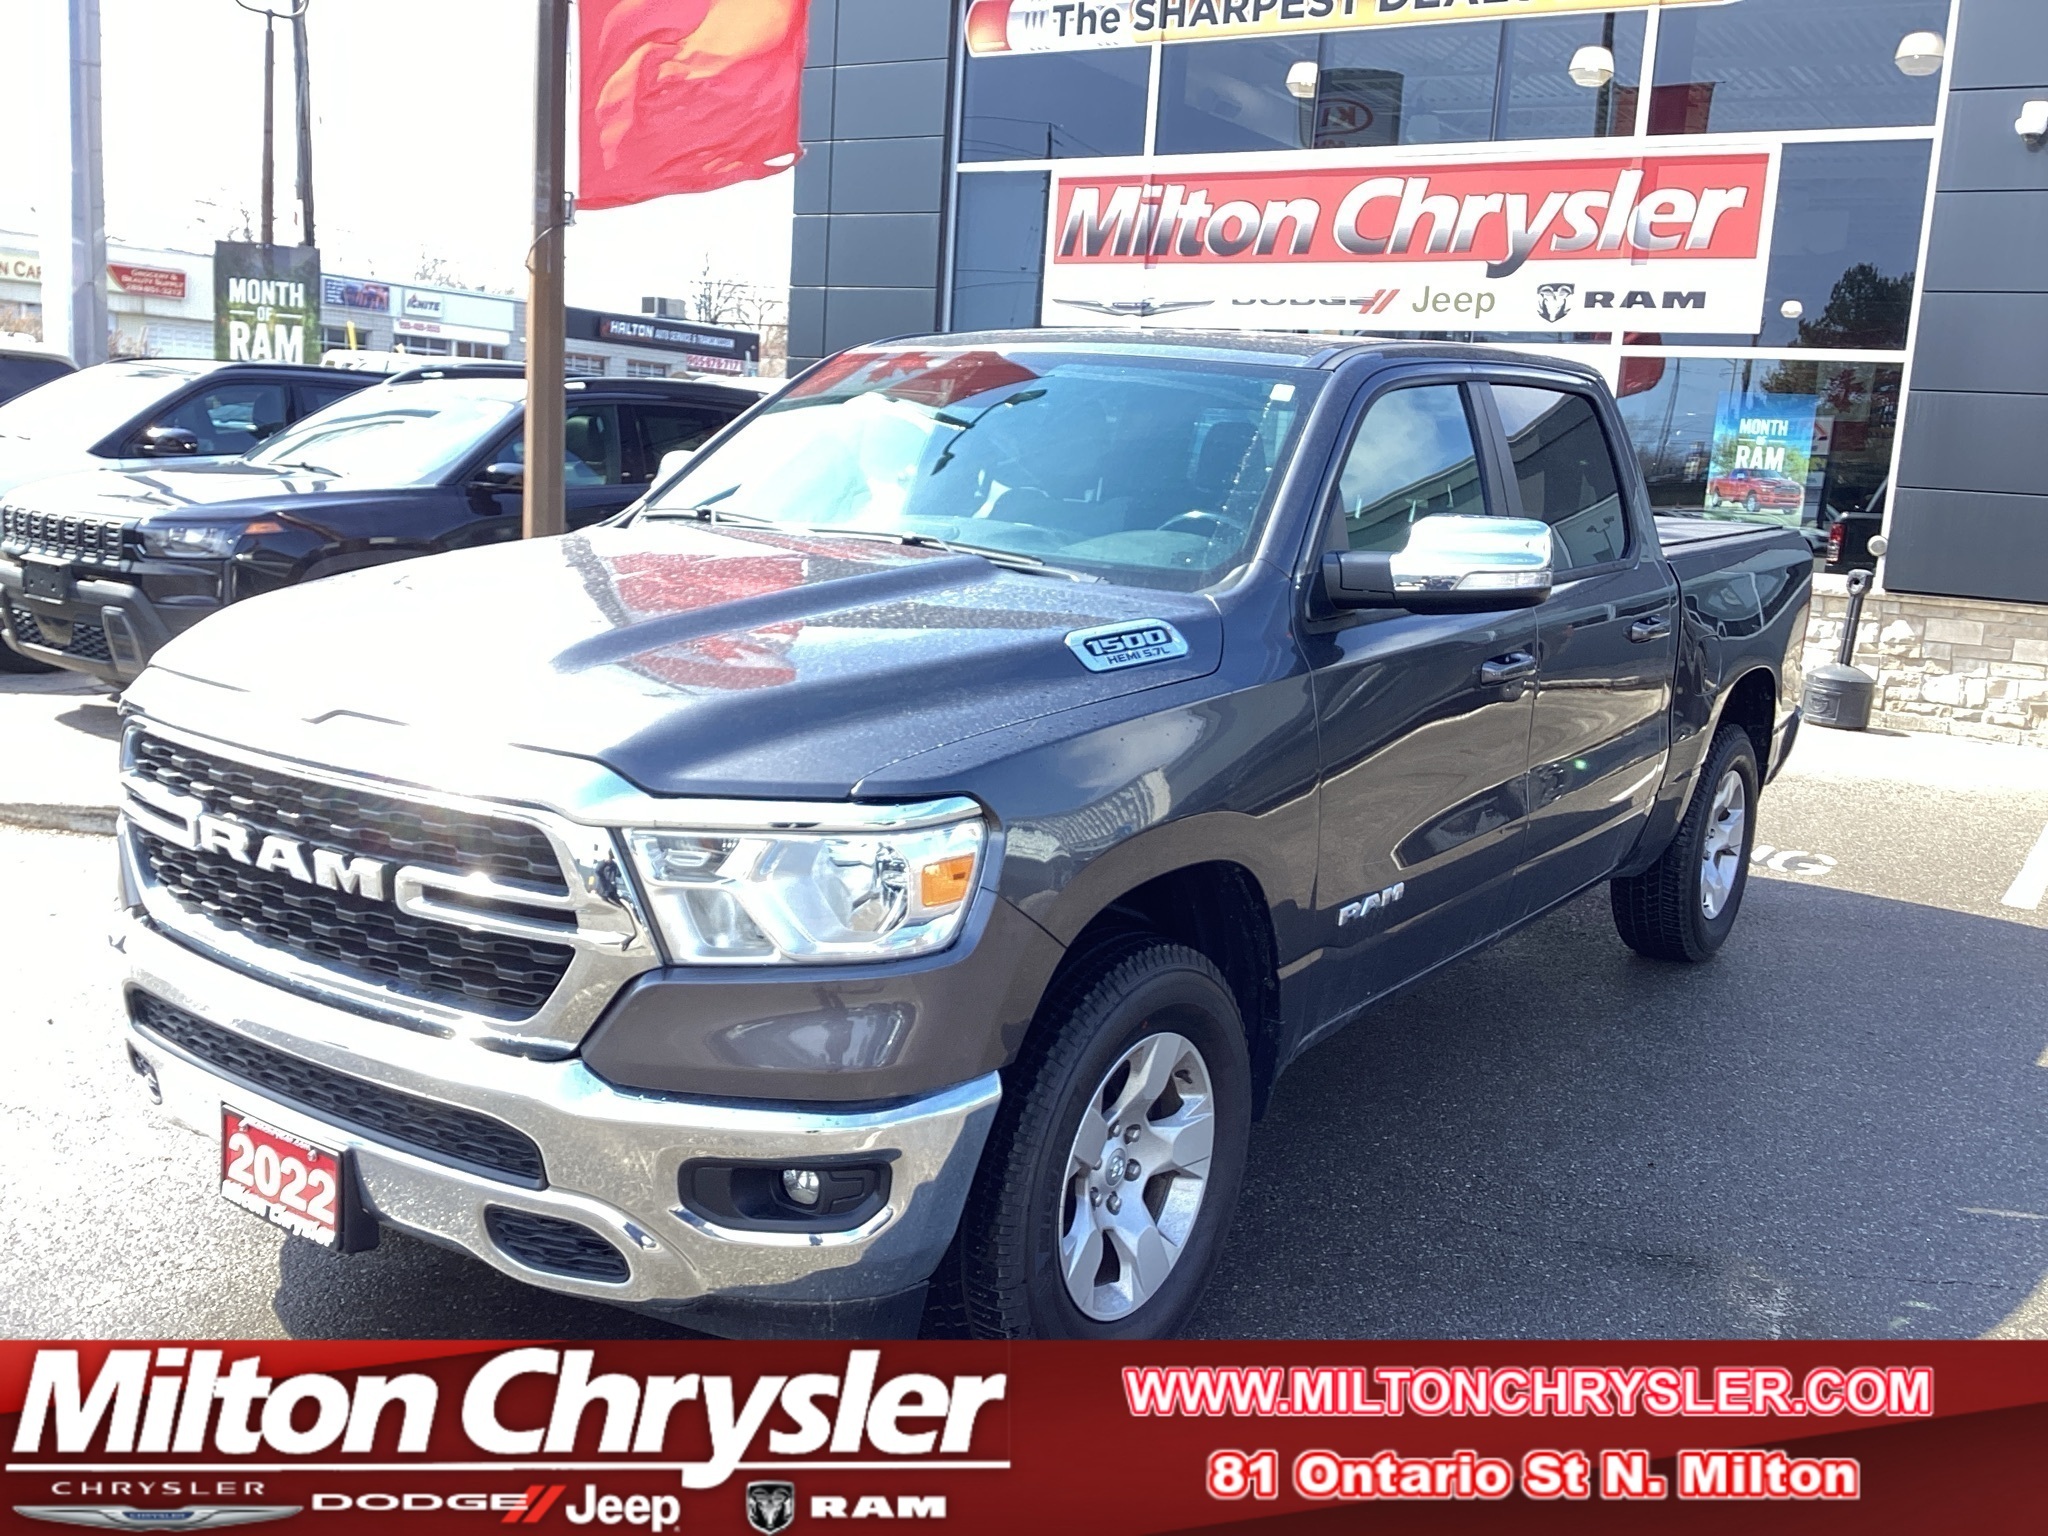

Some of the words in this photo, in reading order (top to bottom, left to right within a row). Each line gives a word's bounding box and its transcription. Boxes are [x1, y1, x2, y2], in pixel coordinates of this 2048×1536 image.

[1053, 4, 1121, 37] The
[1057, 183, 1322, 257] Milton
[1333, 169, 1750, 279] Chrysler
[229, 277, 305, 308] MONTH
[1412, 285, 1496, 319] Jeep
[1584, 291, 1707, 309] RAM
[256, 307, 274, 322] OF
[610, 320, 655, 338] HALTON
[229, 320, 304, 365] RAM
[1739, 418, 1789, 436] MONTH
[1735, 445, 1786, 473] RAM
[1085, 628, 1168, 655] 1500
[1106, 651, 1141, 665] HEMI
[1143, 646, 1171, 658] 5.7L
[199, 812, 390, 901] RAM
[1338, 881, 1405, 926] RAM
[227, 1132, 337, 1226] 2022
